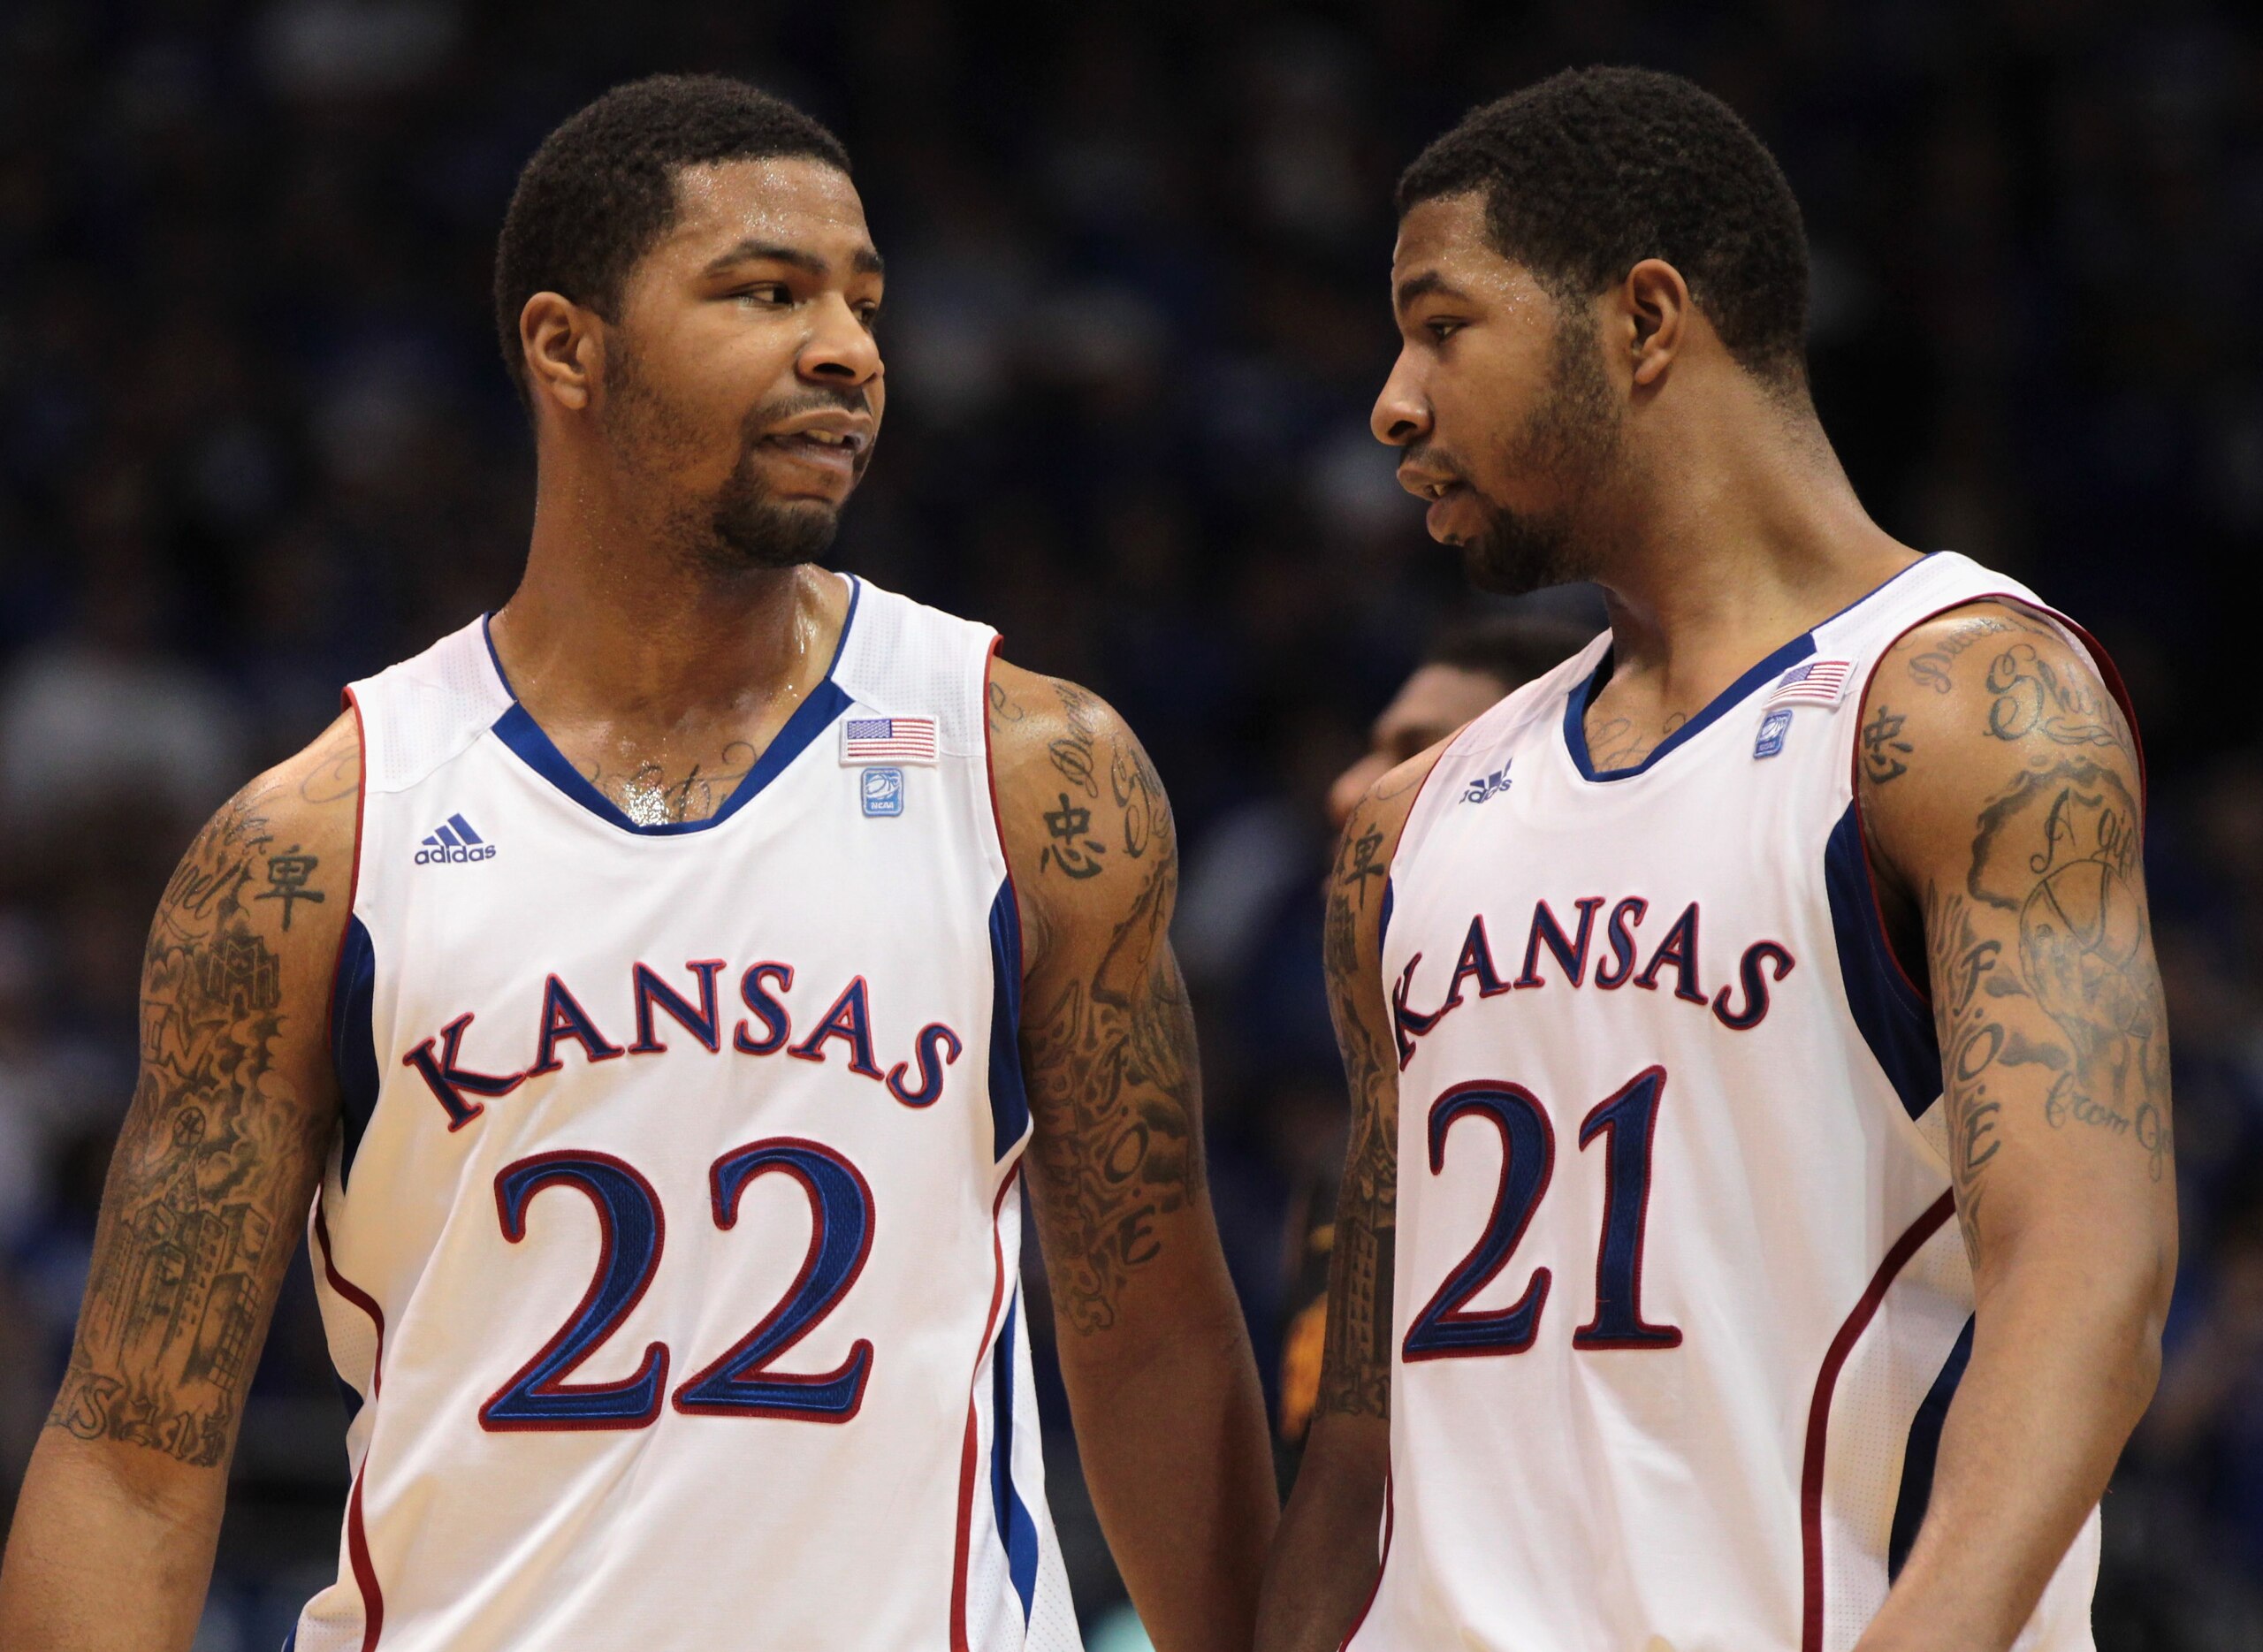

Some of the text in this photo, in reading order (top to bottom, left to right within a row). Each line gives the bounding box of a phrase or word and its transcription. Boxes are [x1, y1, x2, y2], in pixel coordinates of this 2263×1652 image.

[415, 845, 496, 865] adidas
[871, 801, 894, 810] NCAA
[1040, 793, 1106, 879] 忠
[402, 958, 962, 1131] KANSAS
[1391, 895, 1795, 1071] KANSAS
[478, 1136, 875, 1432] 22
[1402, 1064, 1683, 1363] 21
